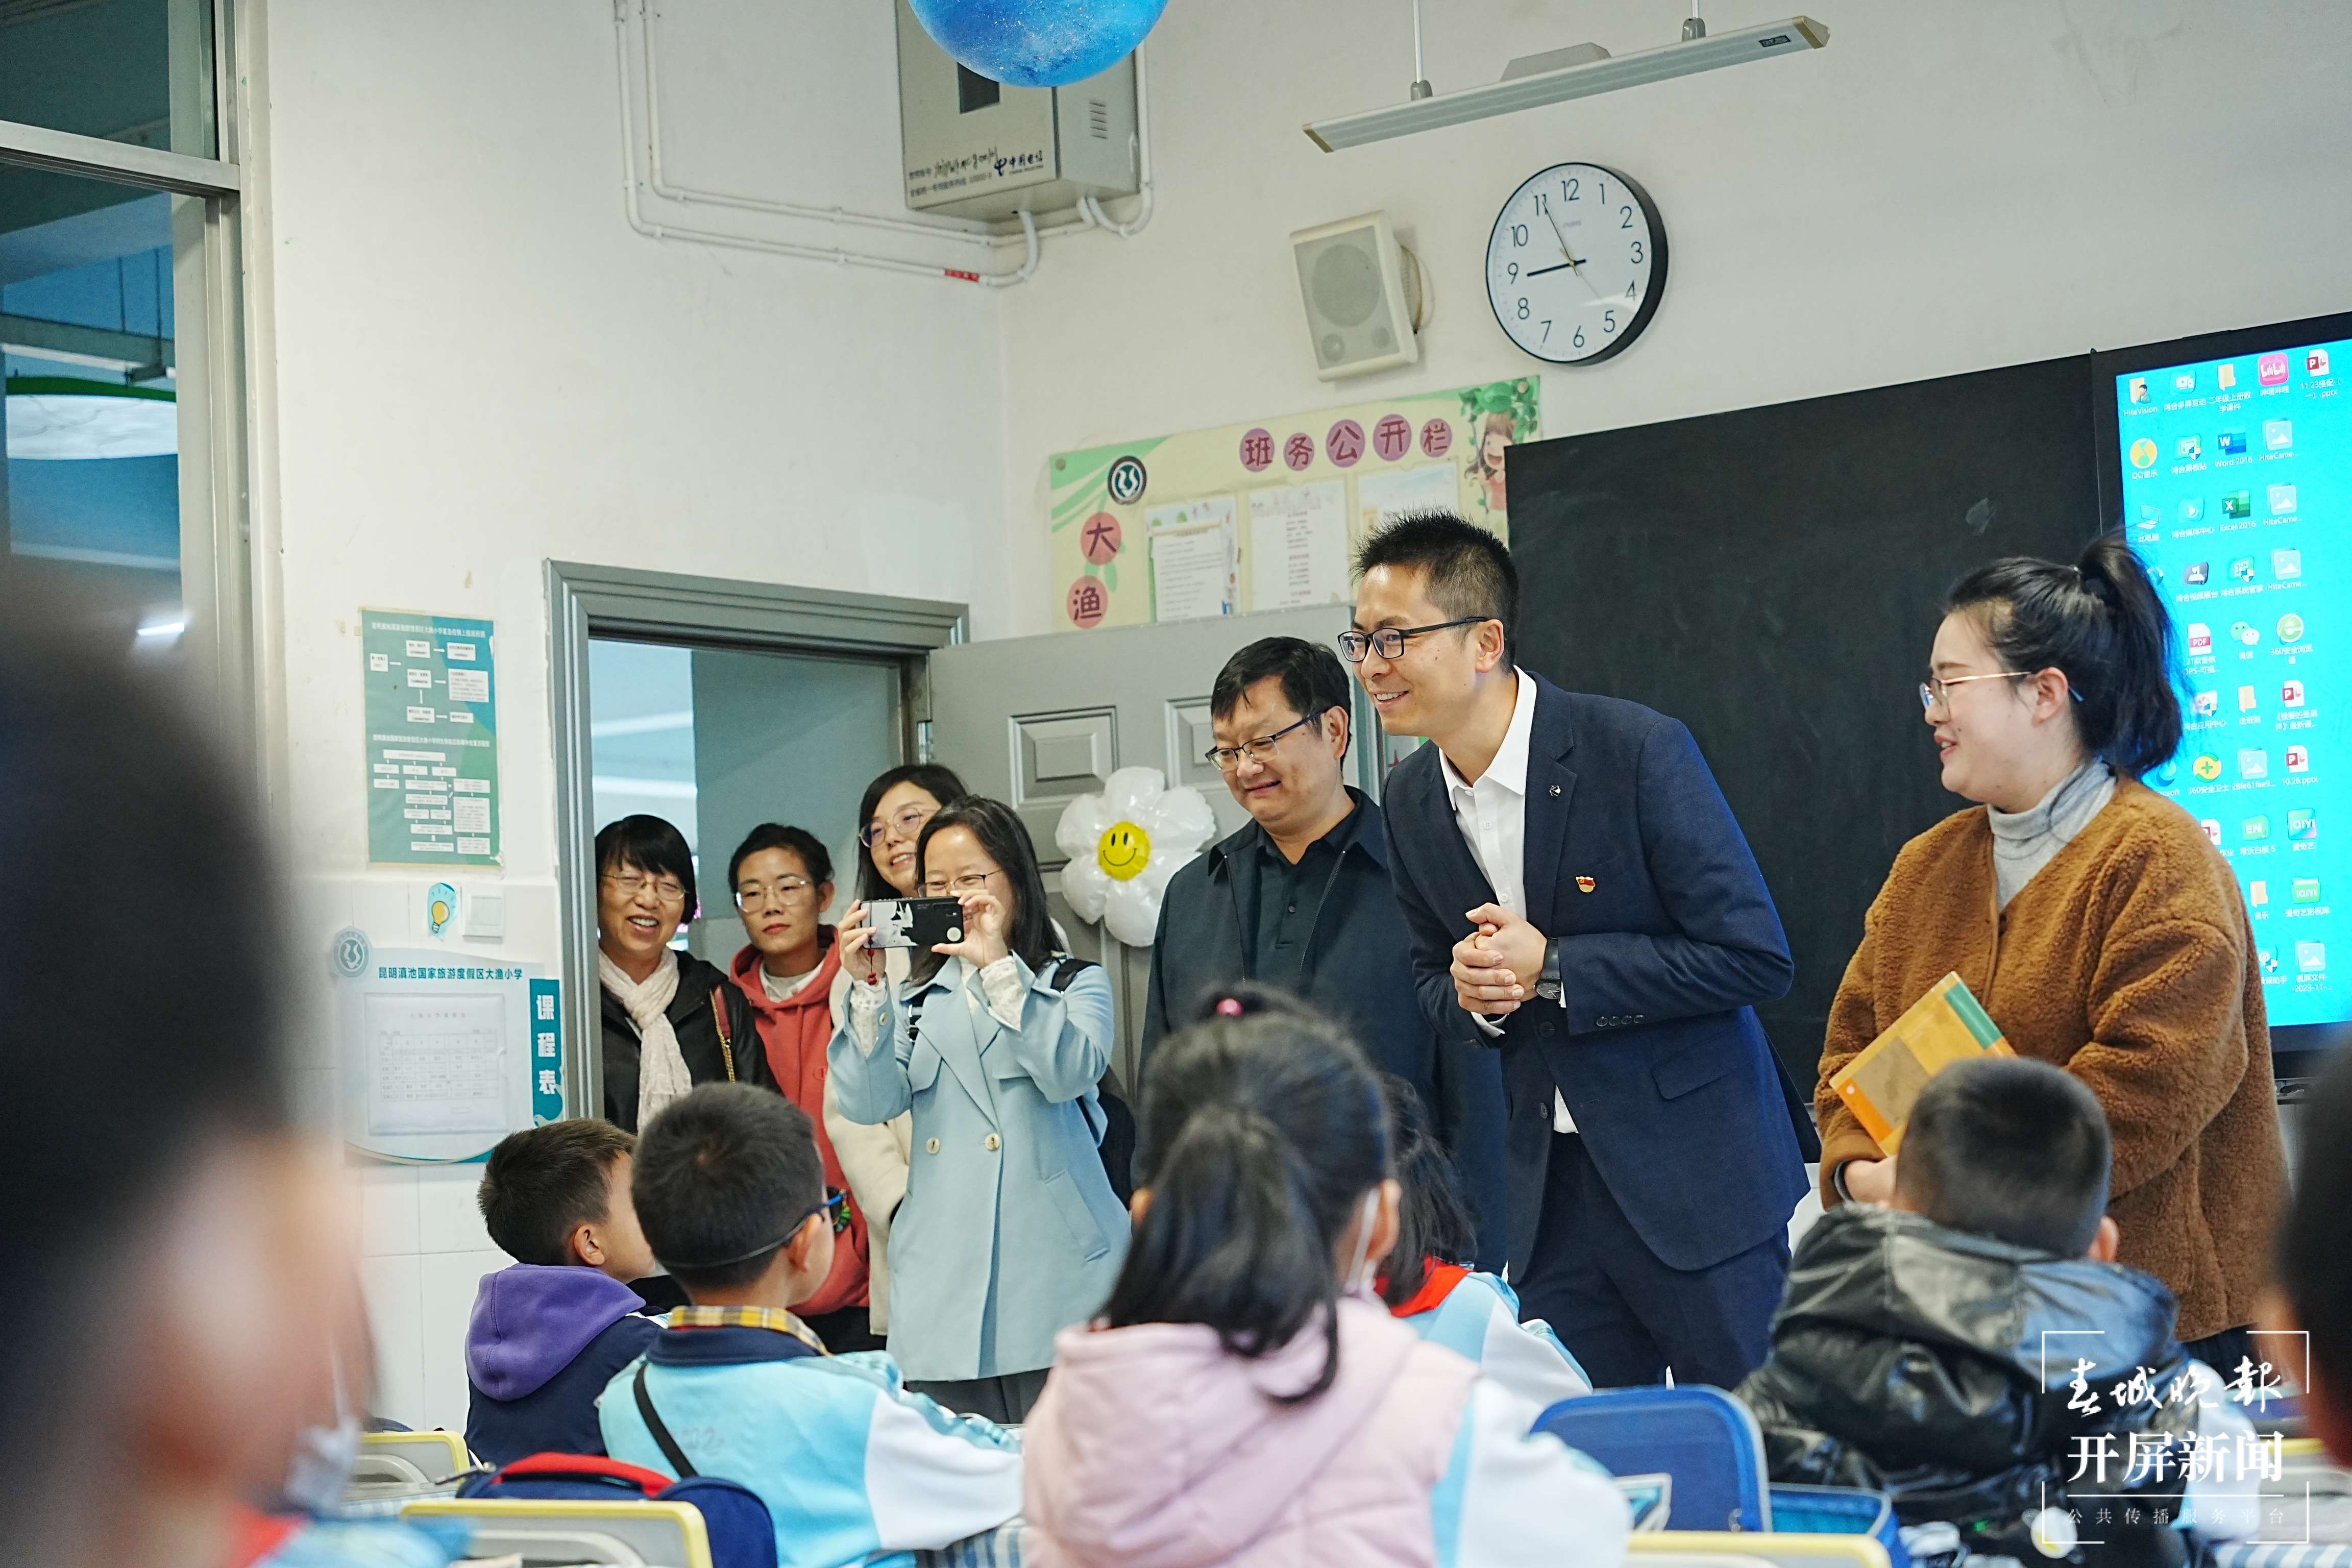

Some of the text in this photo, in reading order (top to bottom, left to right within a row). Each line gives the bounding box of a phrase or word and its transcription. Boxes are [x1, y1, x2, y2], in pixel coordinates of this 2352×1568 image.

[1561, 179, 1579, 201] 12
[1600, 184, 1604, 204] 1
[1534, 194, 1547, 216] 11
[1620, 206, 1632, 228] 2
[1511, 225, 1528, 247] 10
[1631, 241, 1643, 263] 3
[1508, 263, 1518, 284] 9
[1625, 280, 1636, 300] 4
[1518, 298, 1529, 319] 8
[1541, 320, 1552, 343] 7
[1604, 310, 1615, 332] 5
[1573, 326, 1584, 348] 6
[2123, 406, 2158, 416] HiteVision
[1244, 419, 1449, 468] 班务公开栏
[2215, 456, 2252, 467] Word 2016
[2220, 520, 2256, 531] Excel 2016
[2246, 822, 2262, 834] EN
[378, 967, 523, 980] 昆明滇池国家旅游度假区大渔小学
[535, 994, 557, 1095] 课程表
